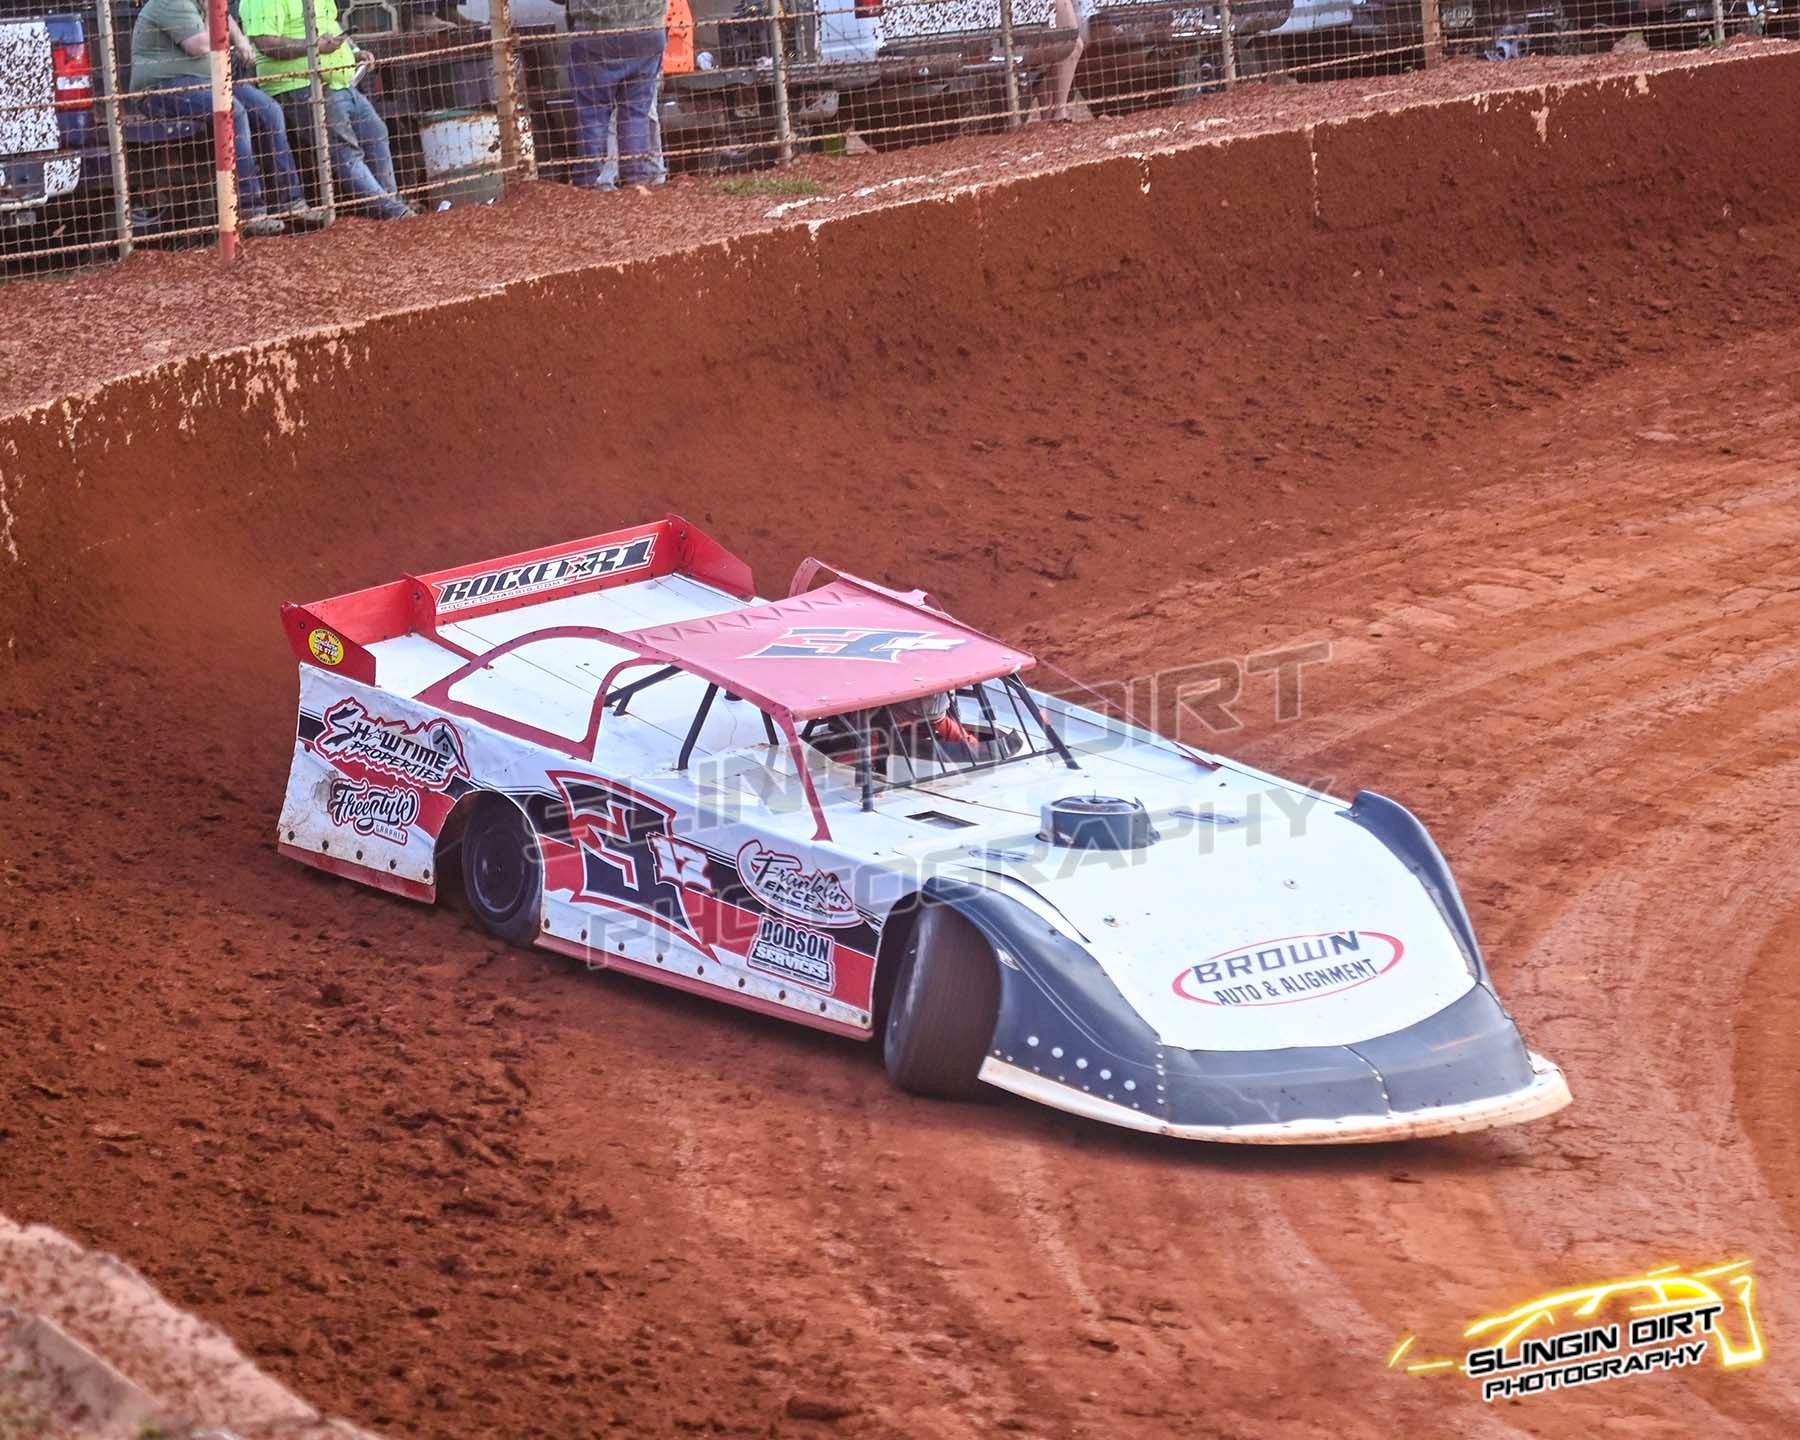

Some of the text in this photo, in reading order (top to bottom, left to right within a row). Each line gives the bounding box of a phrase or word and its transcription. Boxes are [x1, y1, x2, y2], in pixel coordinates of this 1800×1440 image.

[350, 741, 443, 783] PROPERTIES
[752, 855, 848, 906] Franklin
[755, 944, 828, 978] SERVICES
[761, 920, 830, 962] DODSON
[1192, 930, 1360, 985] BROWN
[1213, 958, 1379, 1007] AUTO & ALIGNMENT
